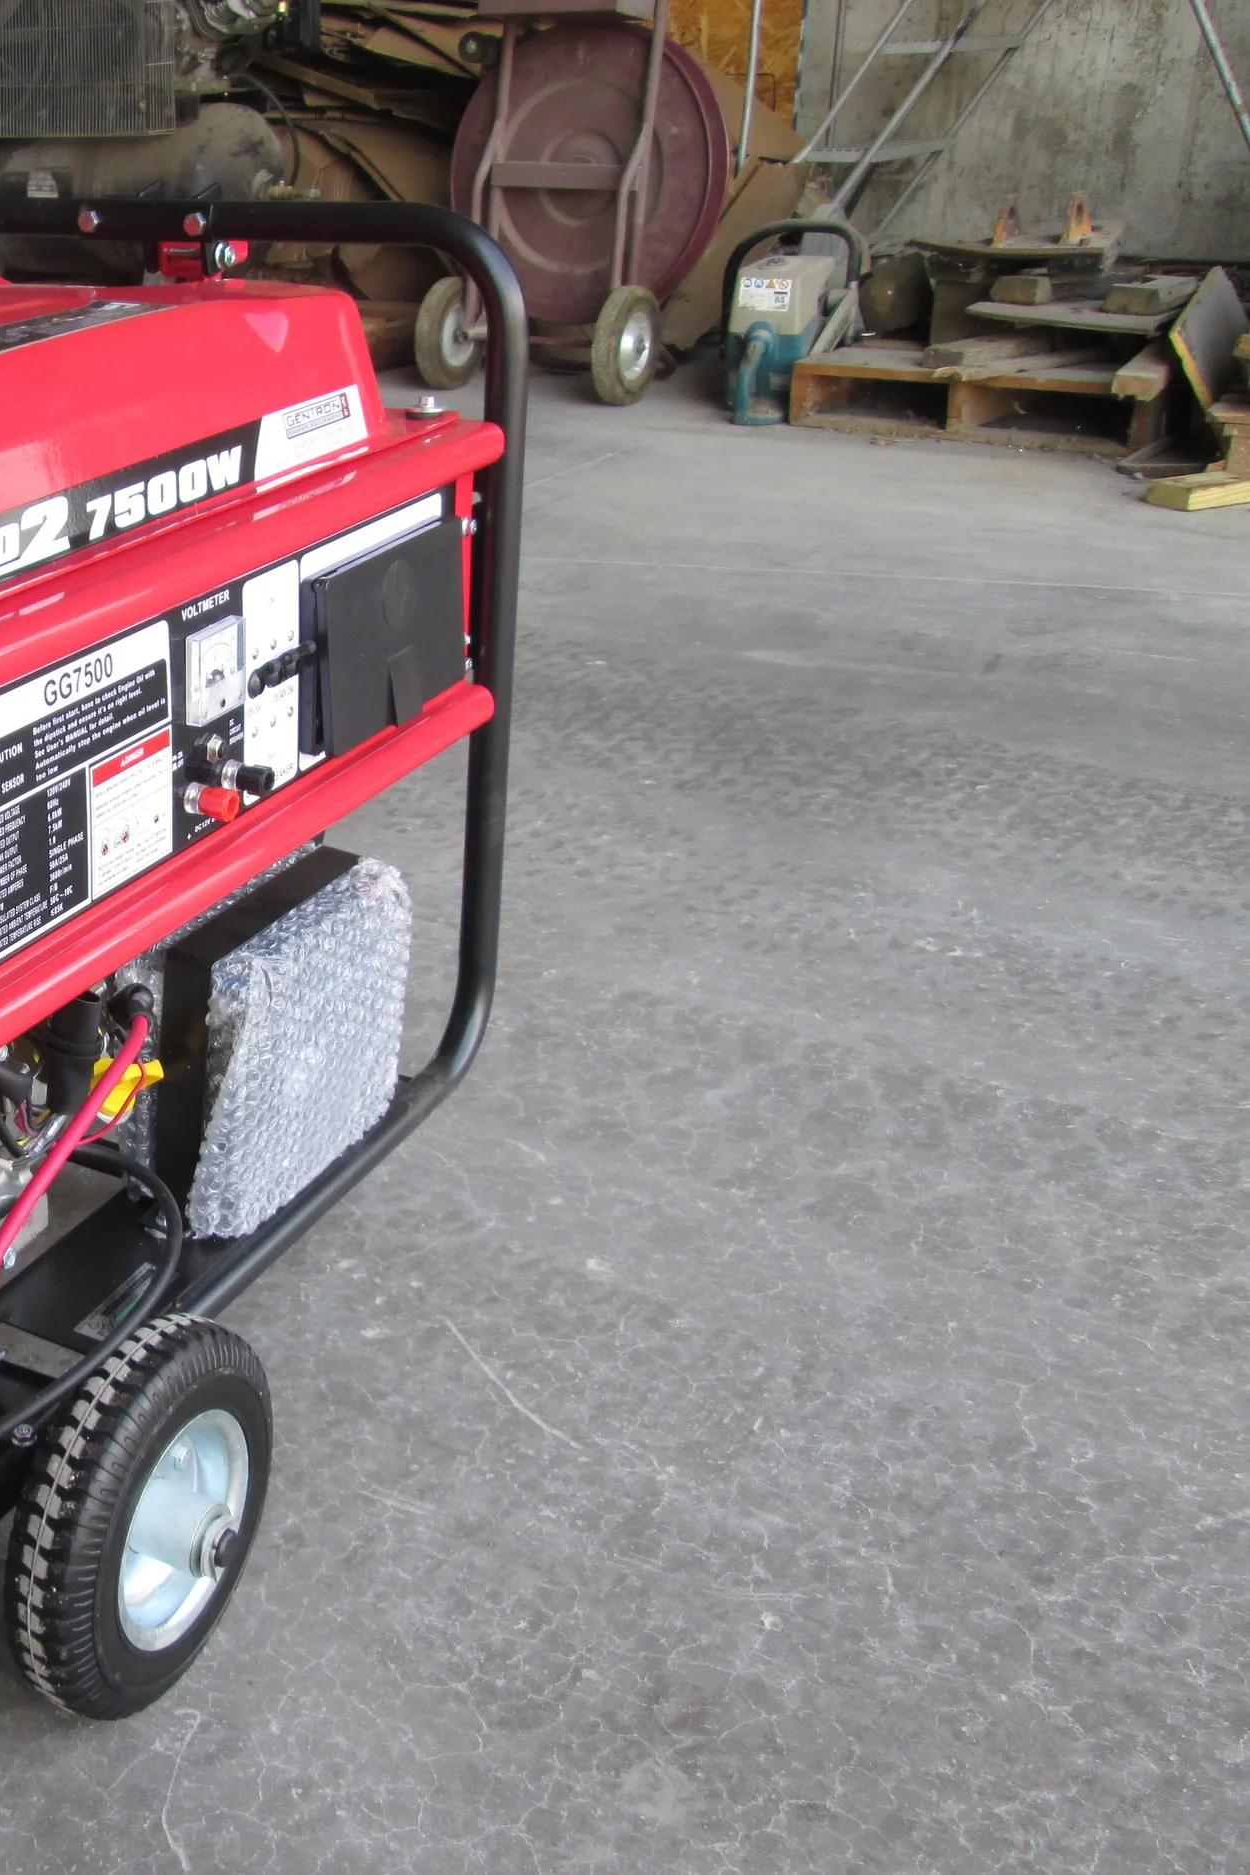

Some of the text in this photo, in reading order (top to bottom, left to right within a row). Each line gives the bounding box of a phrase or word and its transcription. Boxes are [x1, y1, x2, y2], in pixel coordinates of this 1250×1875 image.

[286, 400, 341, 427] GENTRON
[86, 444, 242, 541] 7500W
[181, 589, 230, 621] VOLTMETER
[44, 653, 113, 707] GG7500
[32, 721, 51, 736] Before
[52, 714, 65, 726] first
[81, 699, 94, 712] have
[94, 697, 101, 705] to
[102, 687, 117, 702] check
[117, 680, 135, 694] Engine
[136, 675, 144, 685] Oil
[144, 668, 156, 680] with
[33, 736, 43, 747] the
[44, 725, 66, 742] dipstick
[67, 720, 77, 730] and
[78, 710, 97, 725] ensure
[107, 702, 114, 710] on
[115, 694, 127, 707] right
[34, 748, 45, 759] See
[46, 738, 64, 752] User's
[65, 726, 88, 743] MANUAL
[89, 722, 97, 731] for
[35, 743, 76, 770] Automatically
[77, 737, 91, 749] stop
[91, 731, 101, 740] the
[102, 721, 121, 736] engine
[122, 713, 137, 724] when
[146, 700, 160, 712] level
[160, 697, 166, 705] is
[1, 773, 25, 794] SENSOR
[35, 765, 59, 782] too low
[48, 831, 84, 859] SINGLE PHASE
